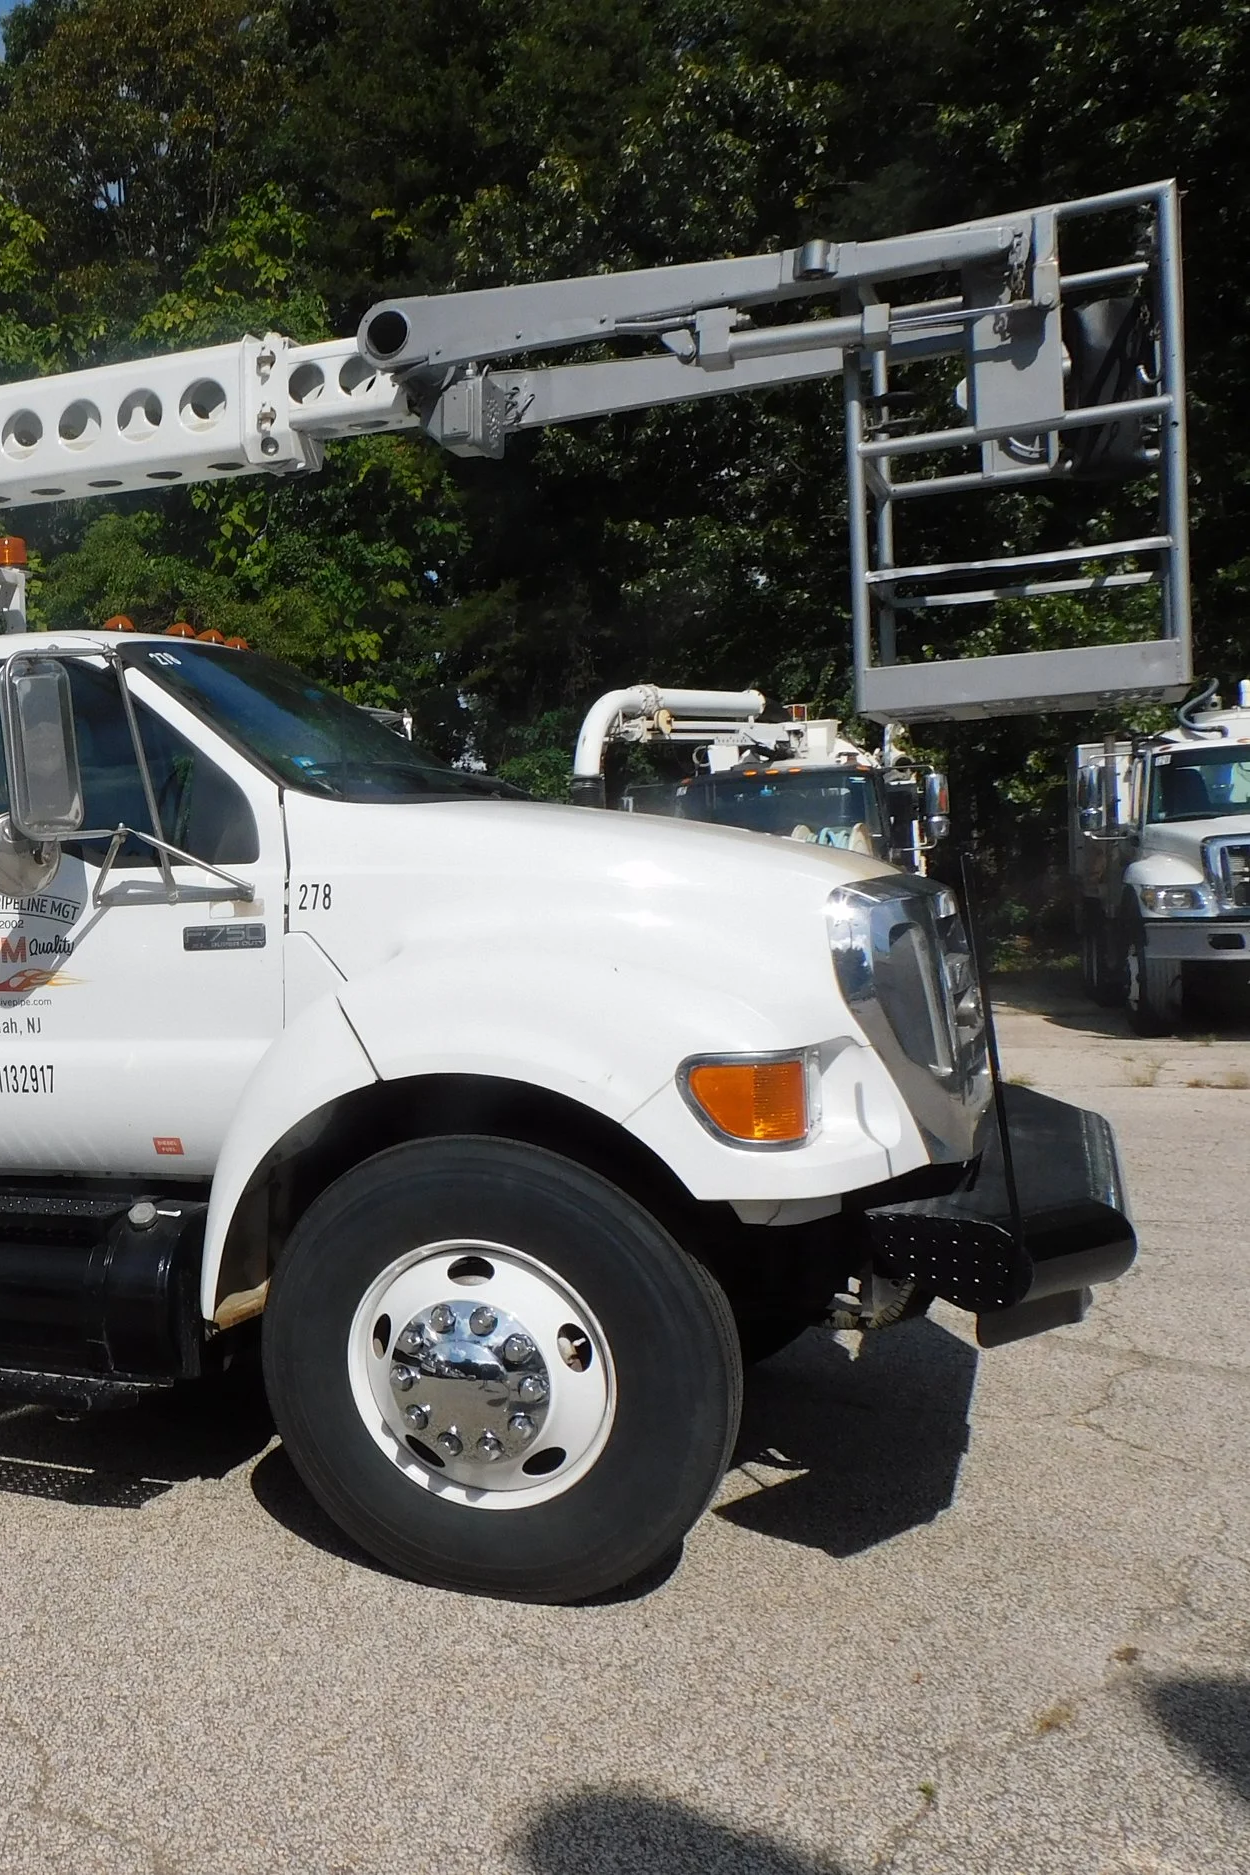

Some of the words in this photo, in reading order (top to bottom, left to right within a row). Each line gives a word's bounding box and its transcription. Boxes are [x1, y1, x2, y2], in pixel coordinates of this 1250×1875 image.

[298, 883, 332, 911] 278
[50, 902, 80, 921] MGT
[29, 935, 75, 957] Quality
[241, 939, 265, 947] DUTY
[27, 1017, 41, 1033] NJ
